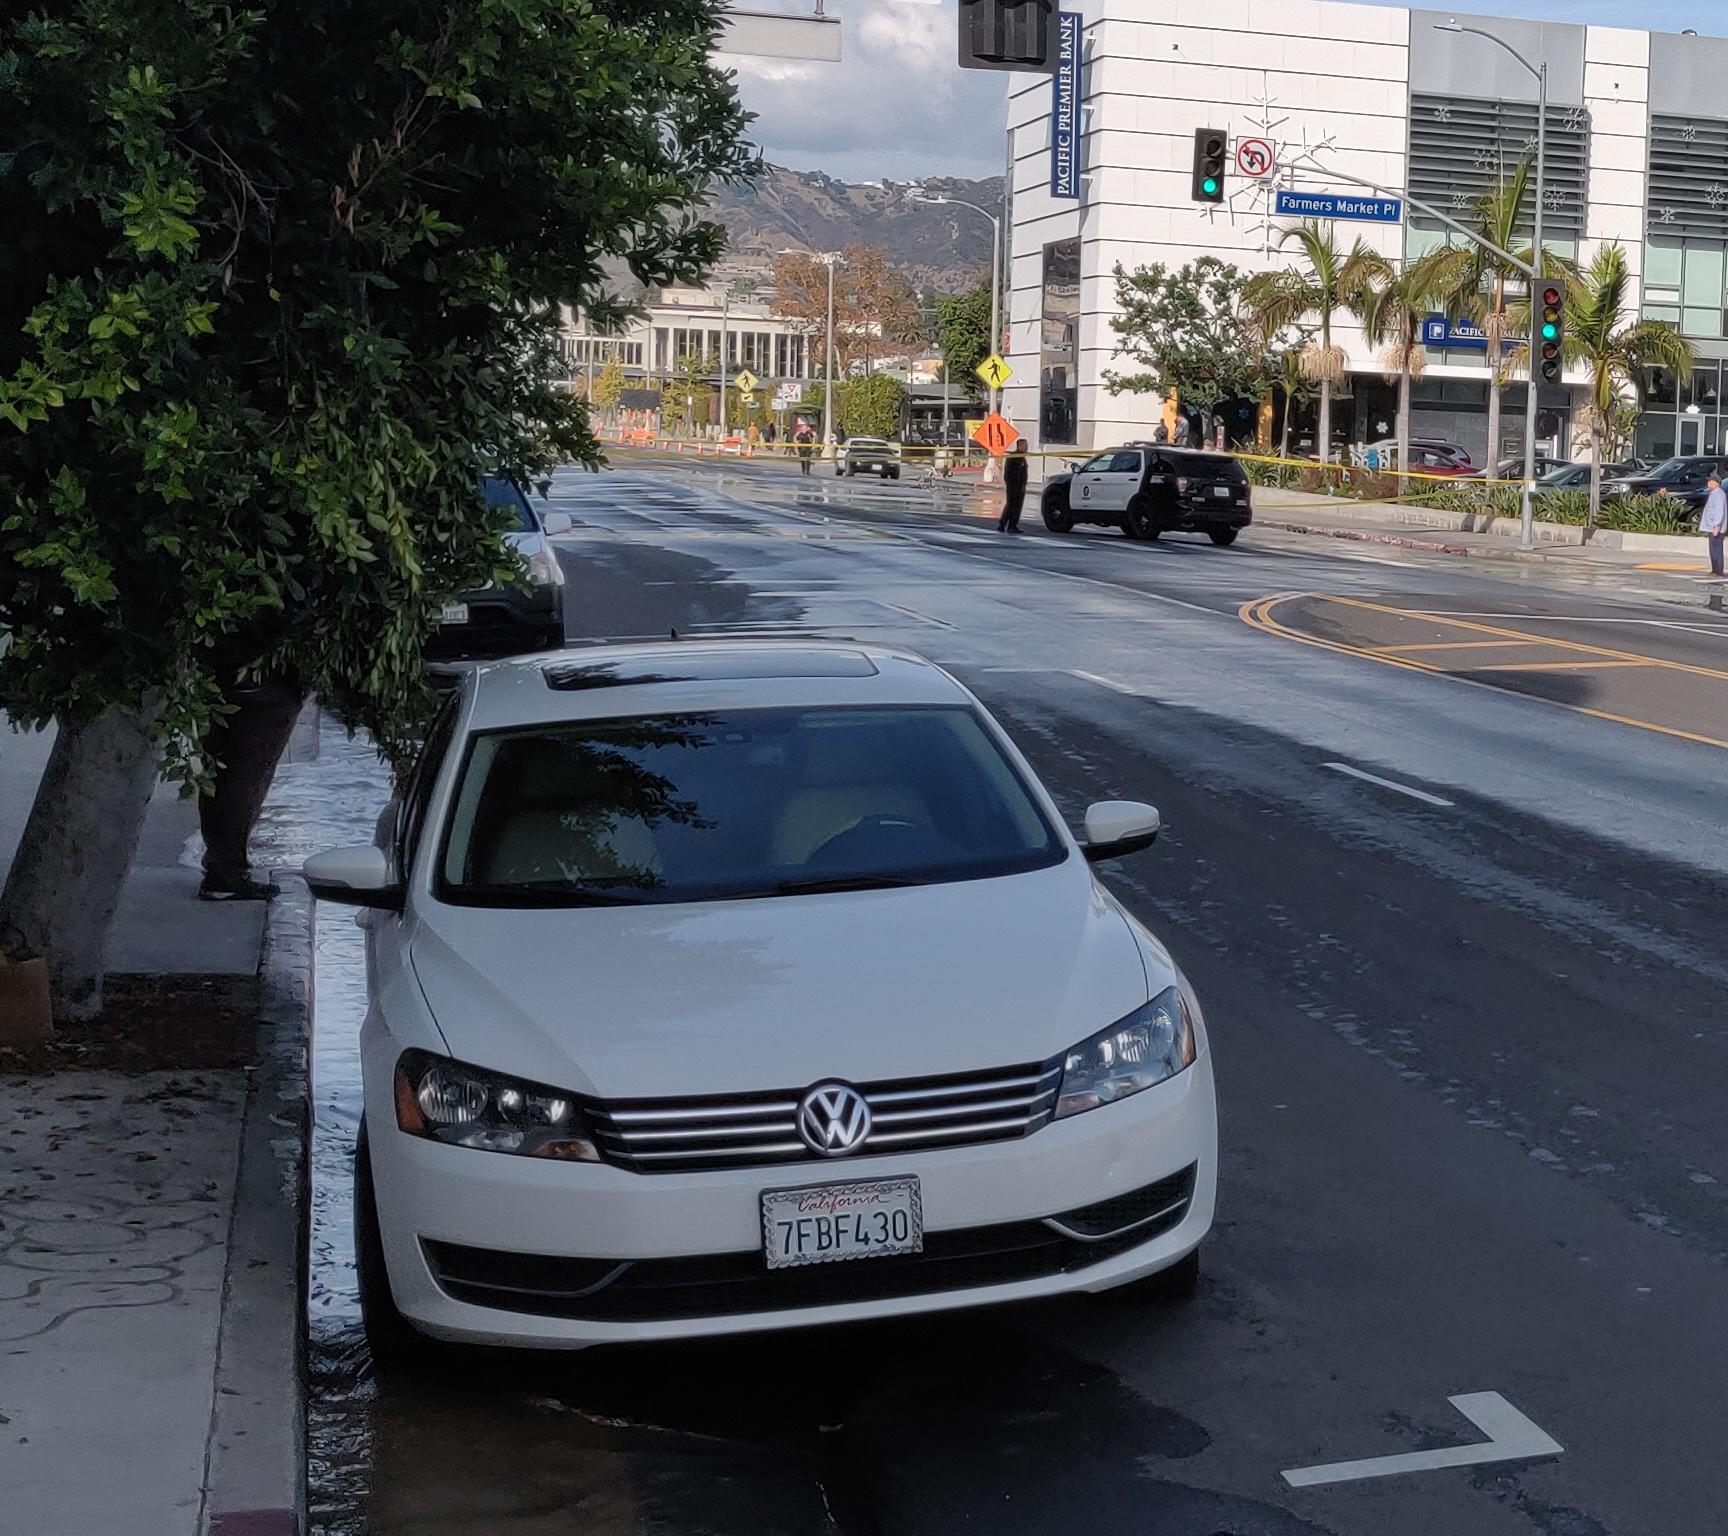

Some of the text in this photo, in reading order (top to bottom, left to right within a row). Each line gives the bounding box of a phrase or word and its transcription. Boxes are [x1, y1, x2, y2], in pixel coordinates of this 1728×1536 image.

[1057, 16, 1073, 194] PACIFIC PREMIER BANK
[1281, 195, 1395, 215] Farmers Market Pl
[798, 1194, 891, 1214] California
[777, 1209, 908, 1255] 7FBF430
